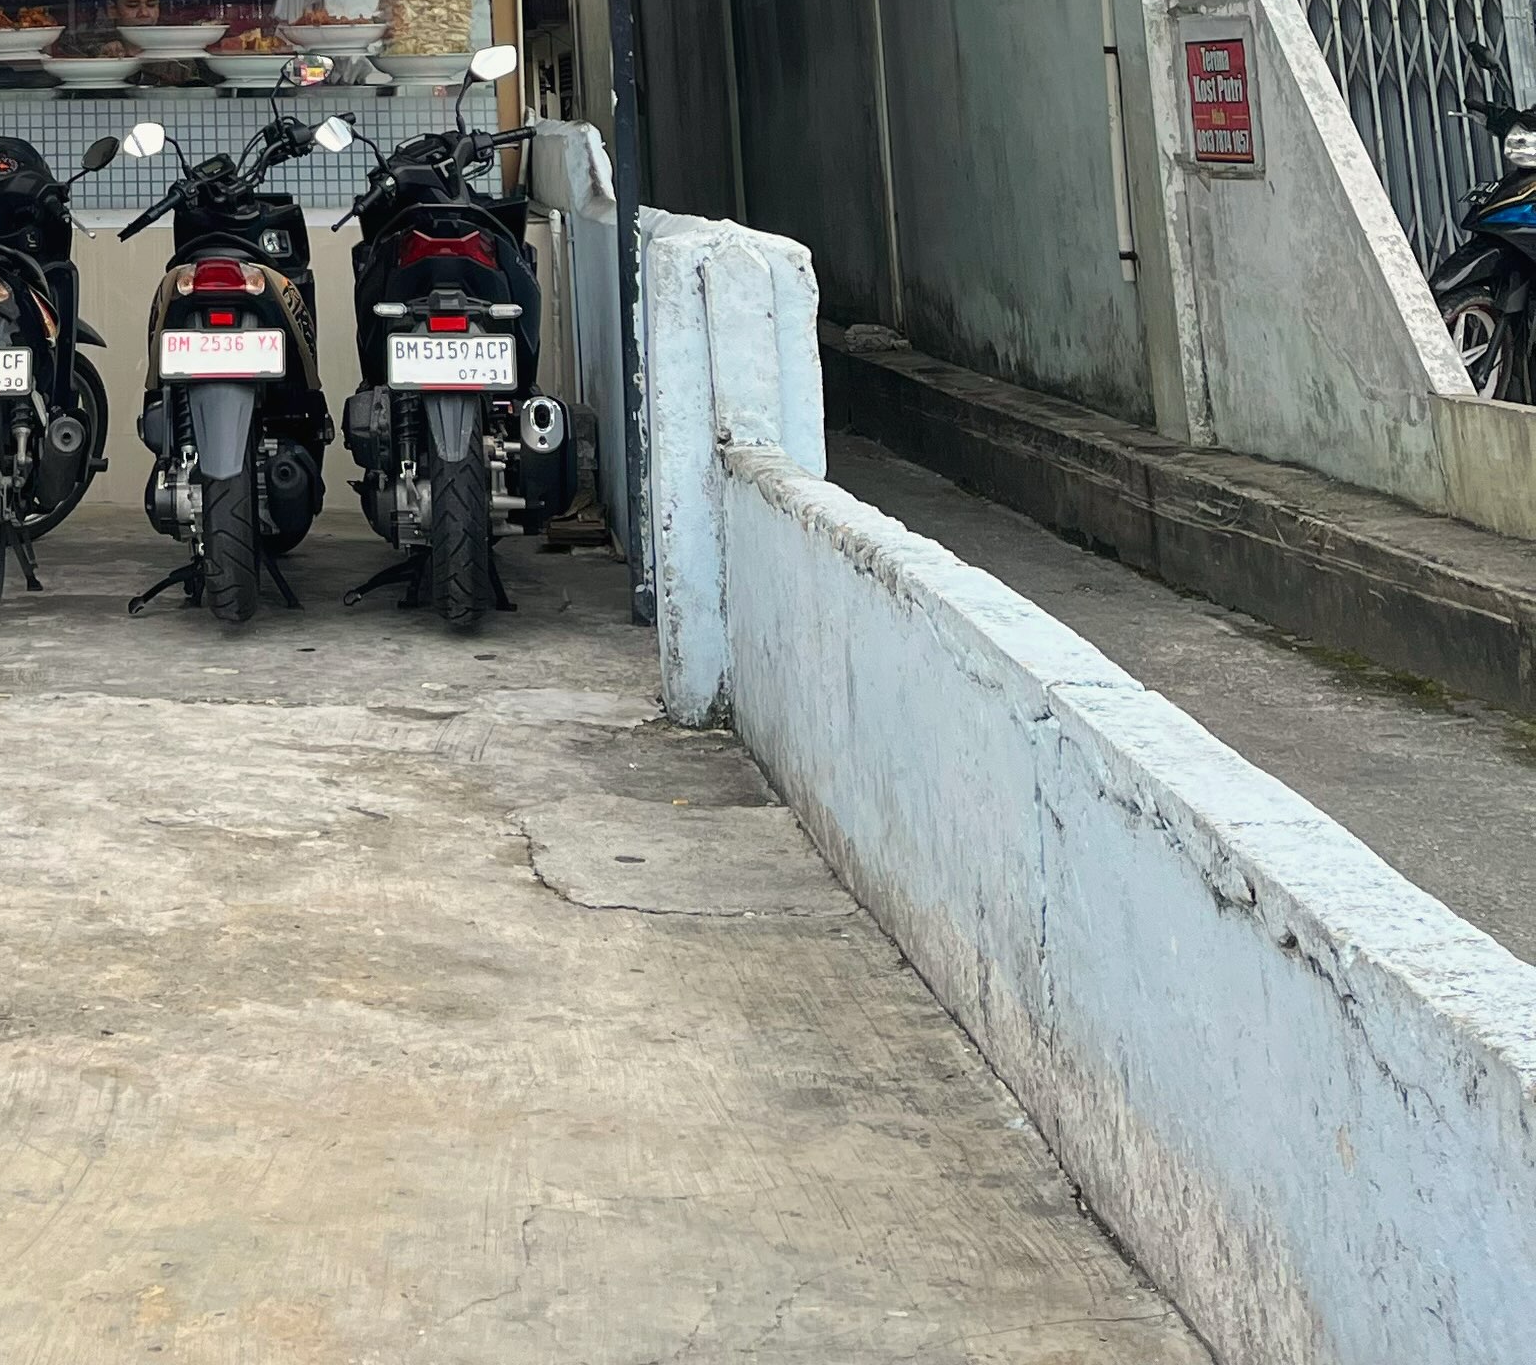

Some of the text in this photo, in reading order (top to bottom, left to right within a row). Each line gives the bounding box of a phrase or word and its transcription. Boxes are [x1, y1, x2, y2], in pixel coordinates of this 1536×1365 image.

[1192, 75, 1217, 103] Kost
[167, 335, 279, 352] BM 2536 YX
[395, 341, 419, 360] BM
[475, 341, 509, 360] ACP
